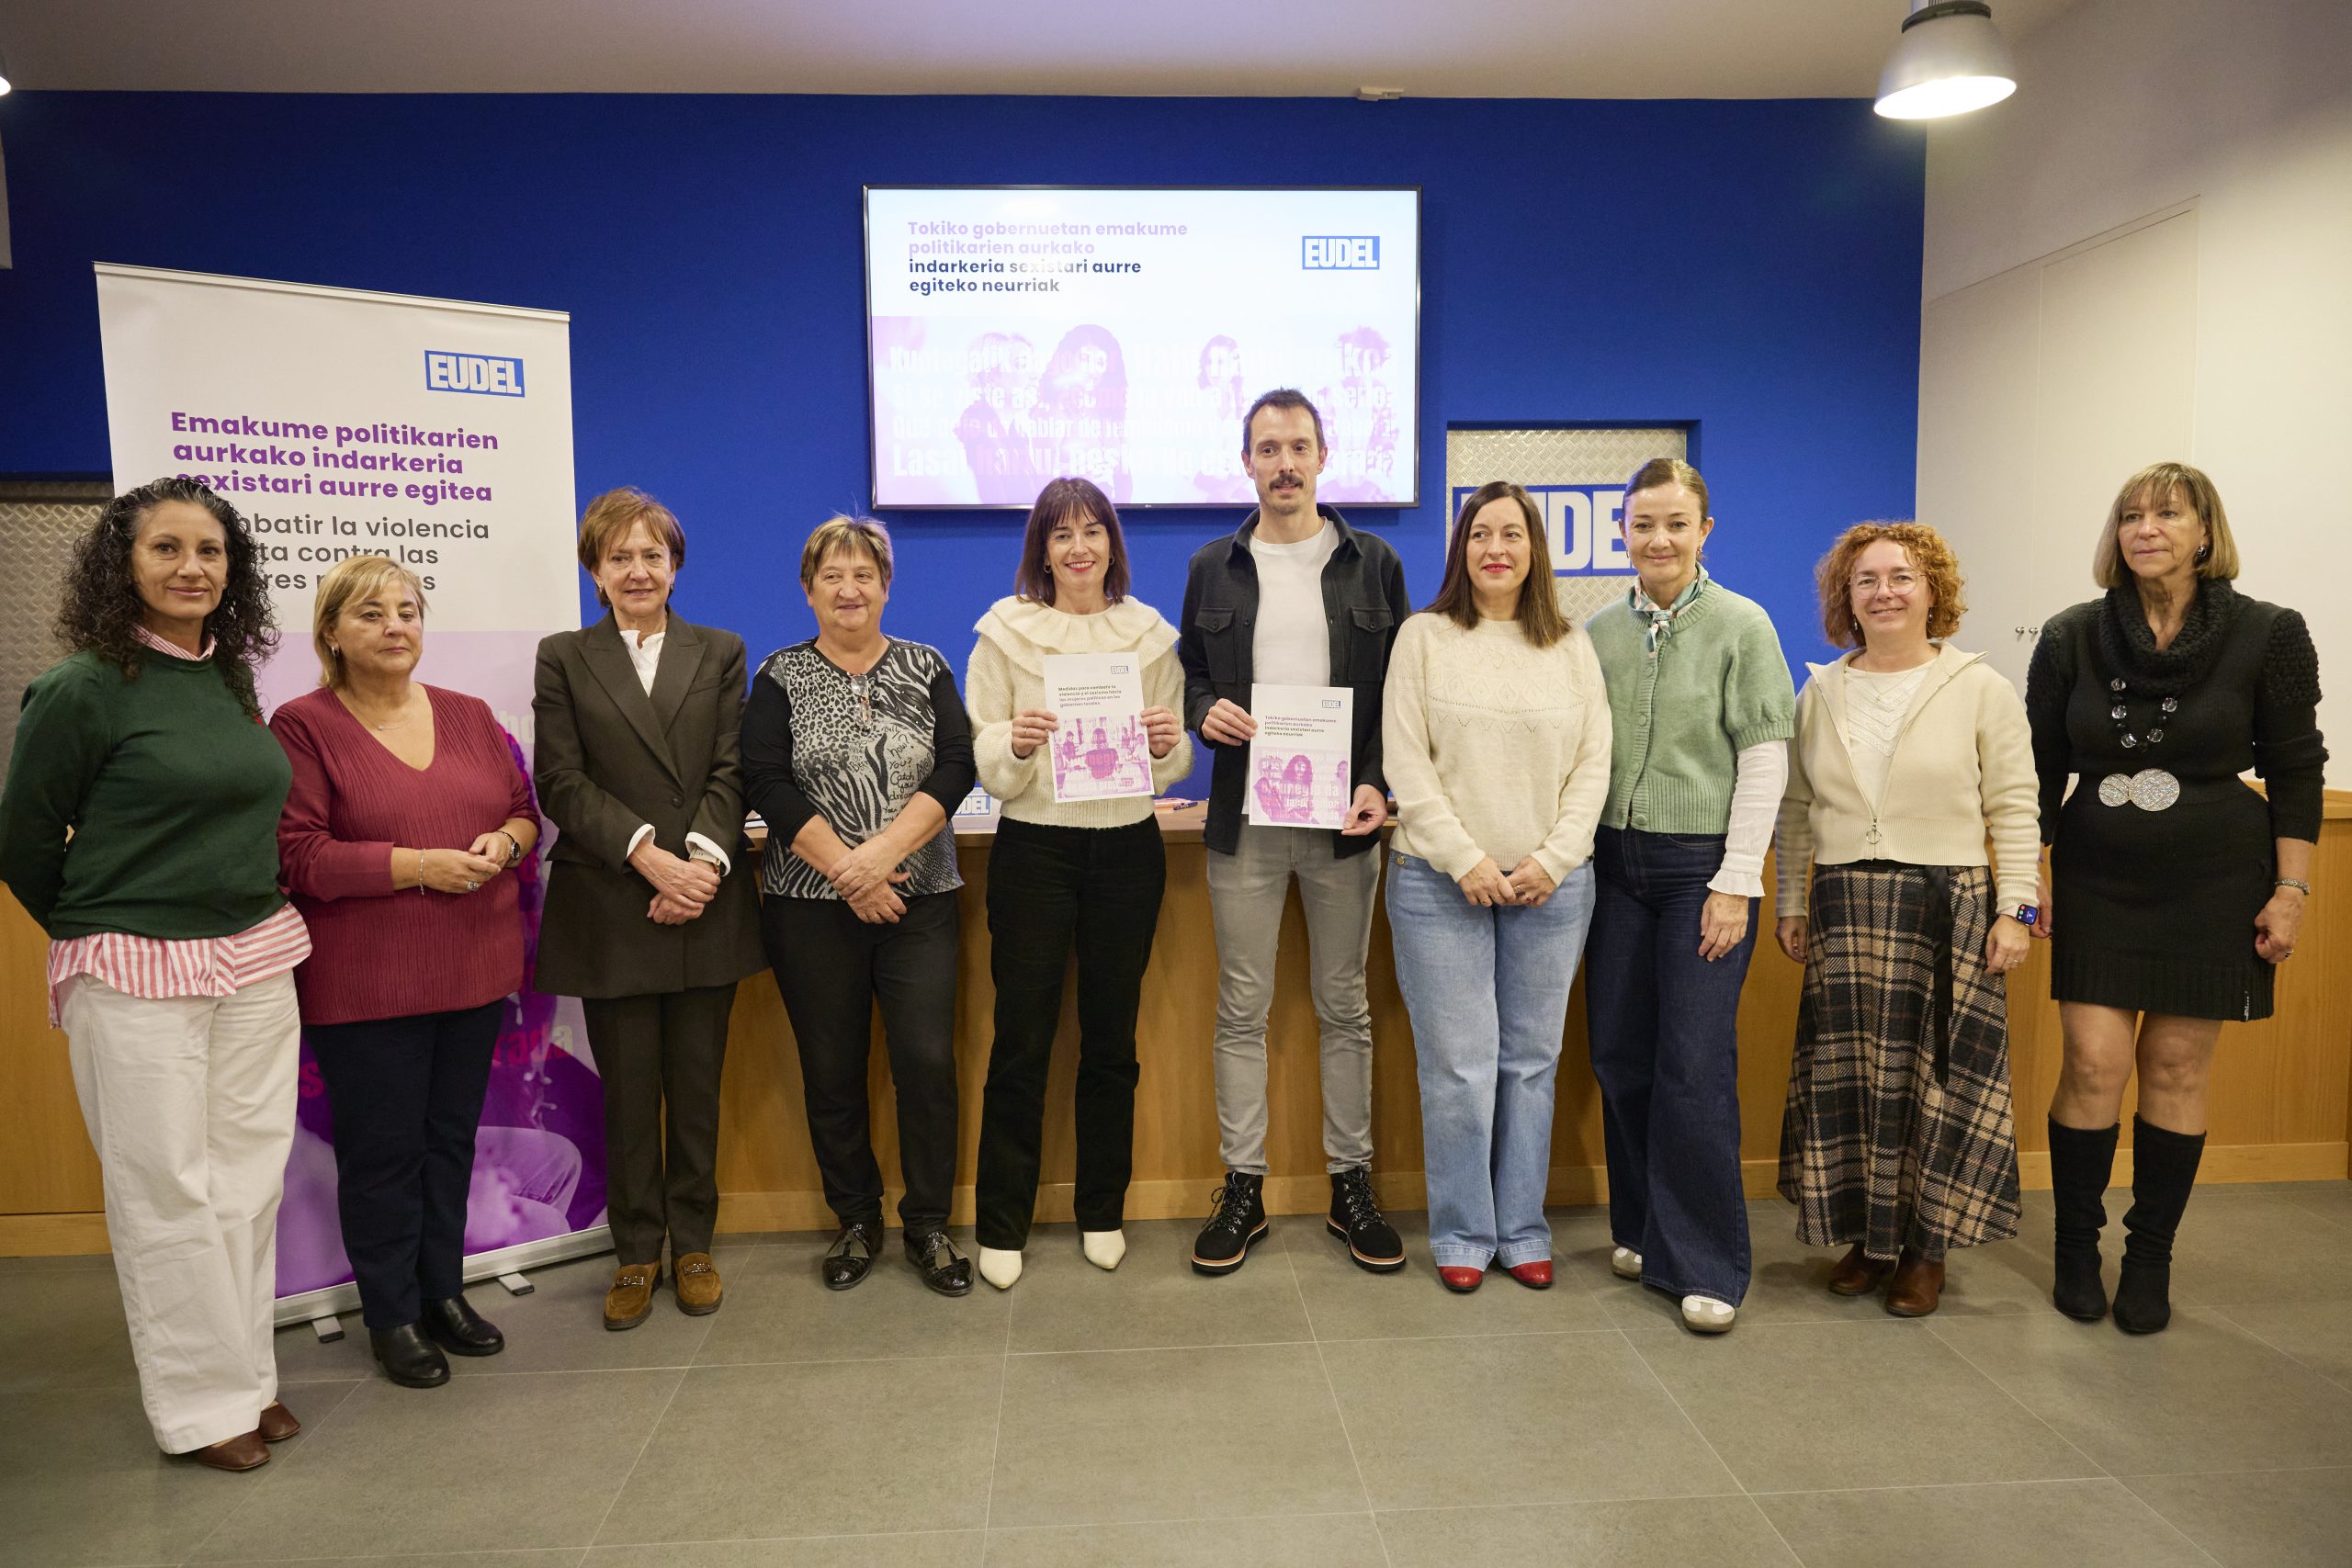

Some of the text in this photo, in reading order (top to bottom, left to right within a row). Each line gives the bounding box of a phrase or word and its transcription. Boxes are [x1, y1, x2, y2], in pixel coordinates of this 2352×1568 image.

[908, 220, 1188, 239] Tokiko gobernuetan emakume
[909, 240, 1095, 258] politikarien aurkako
[1304, 237, 1379, 268] EUDEL
[909, 258, 1141, 273] indarkeria sexistari aurre
[910, 277, 1059, 296] egiteko neurriak
[428, 353, 522, 395] EUDEL
[171, 412, 499, 450] Emakume politikarien
[173, 443, 463, 475] aurkako indarkeria
[319, 477, 399, 499] aurre
[405, 479, 492, 506] egitea
[237, 513, 490, 539] batir la violencia
[400, 545, 438, 564] las
[955, 795, 990, 816] DEL
